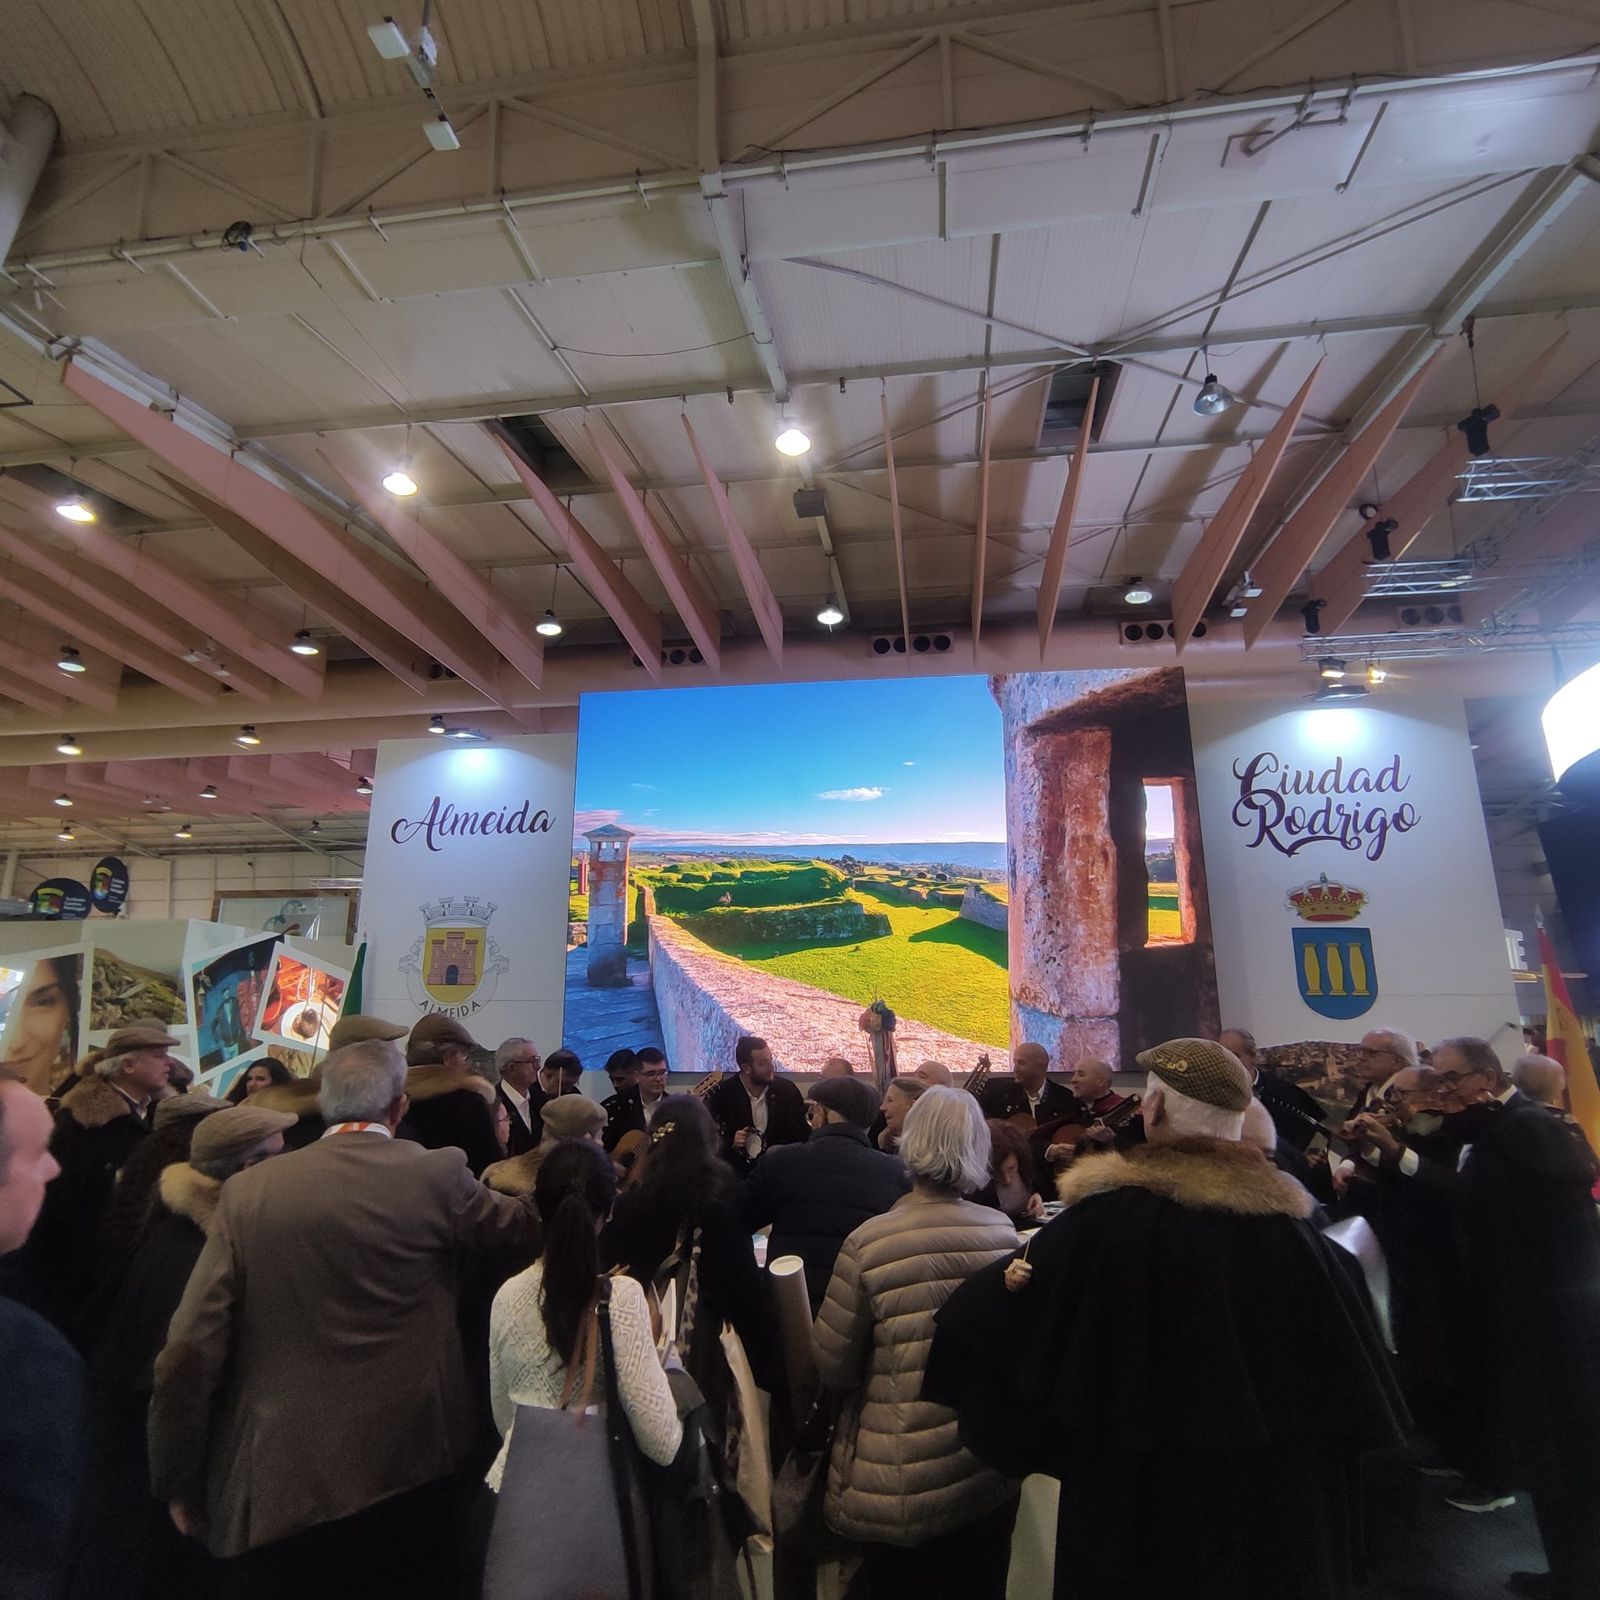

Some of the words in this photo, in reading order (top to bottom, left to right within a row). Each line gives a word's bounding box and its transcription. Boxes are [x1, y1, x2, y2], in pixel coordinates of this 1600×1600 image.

[1232, 752, 1411, 810] Ciudad
[391, 796, 556, 852] Almeida
[1231, 788, 1421, 861] Rodrigo
